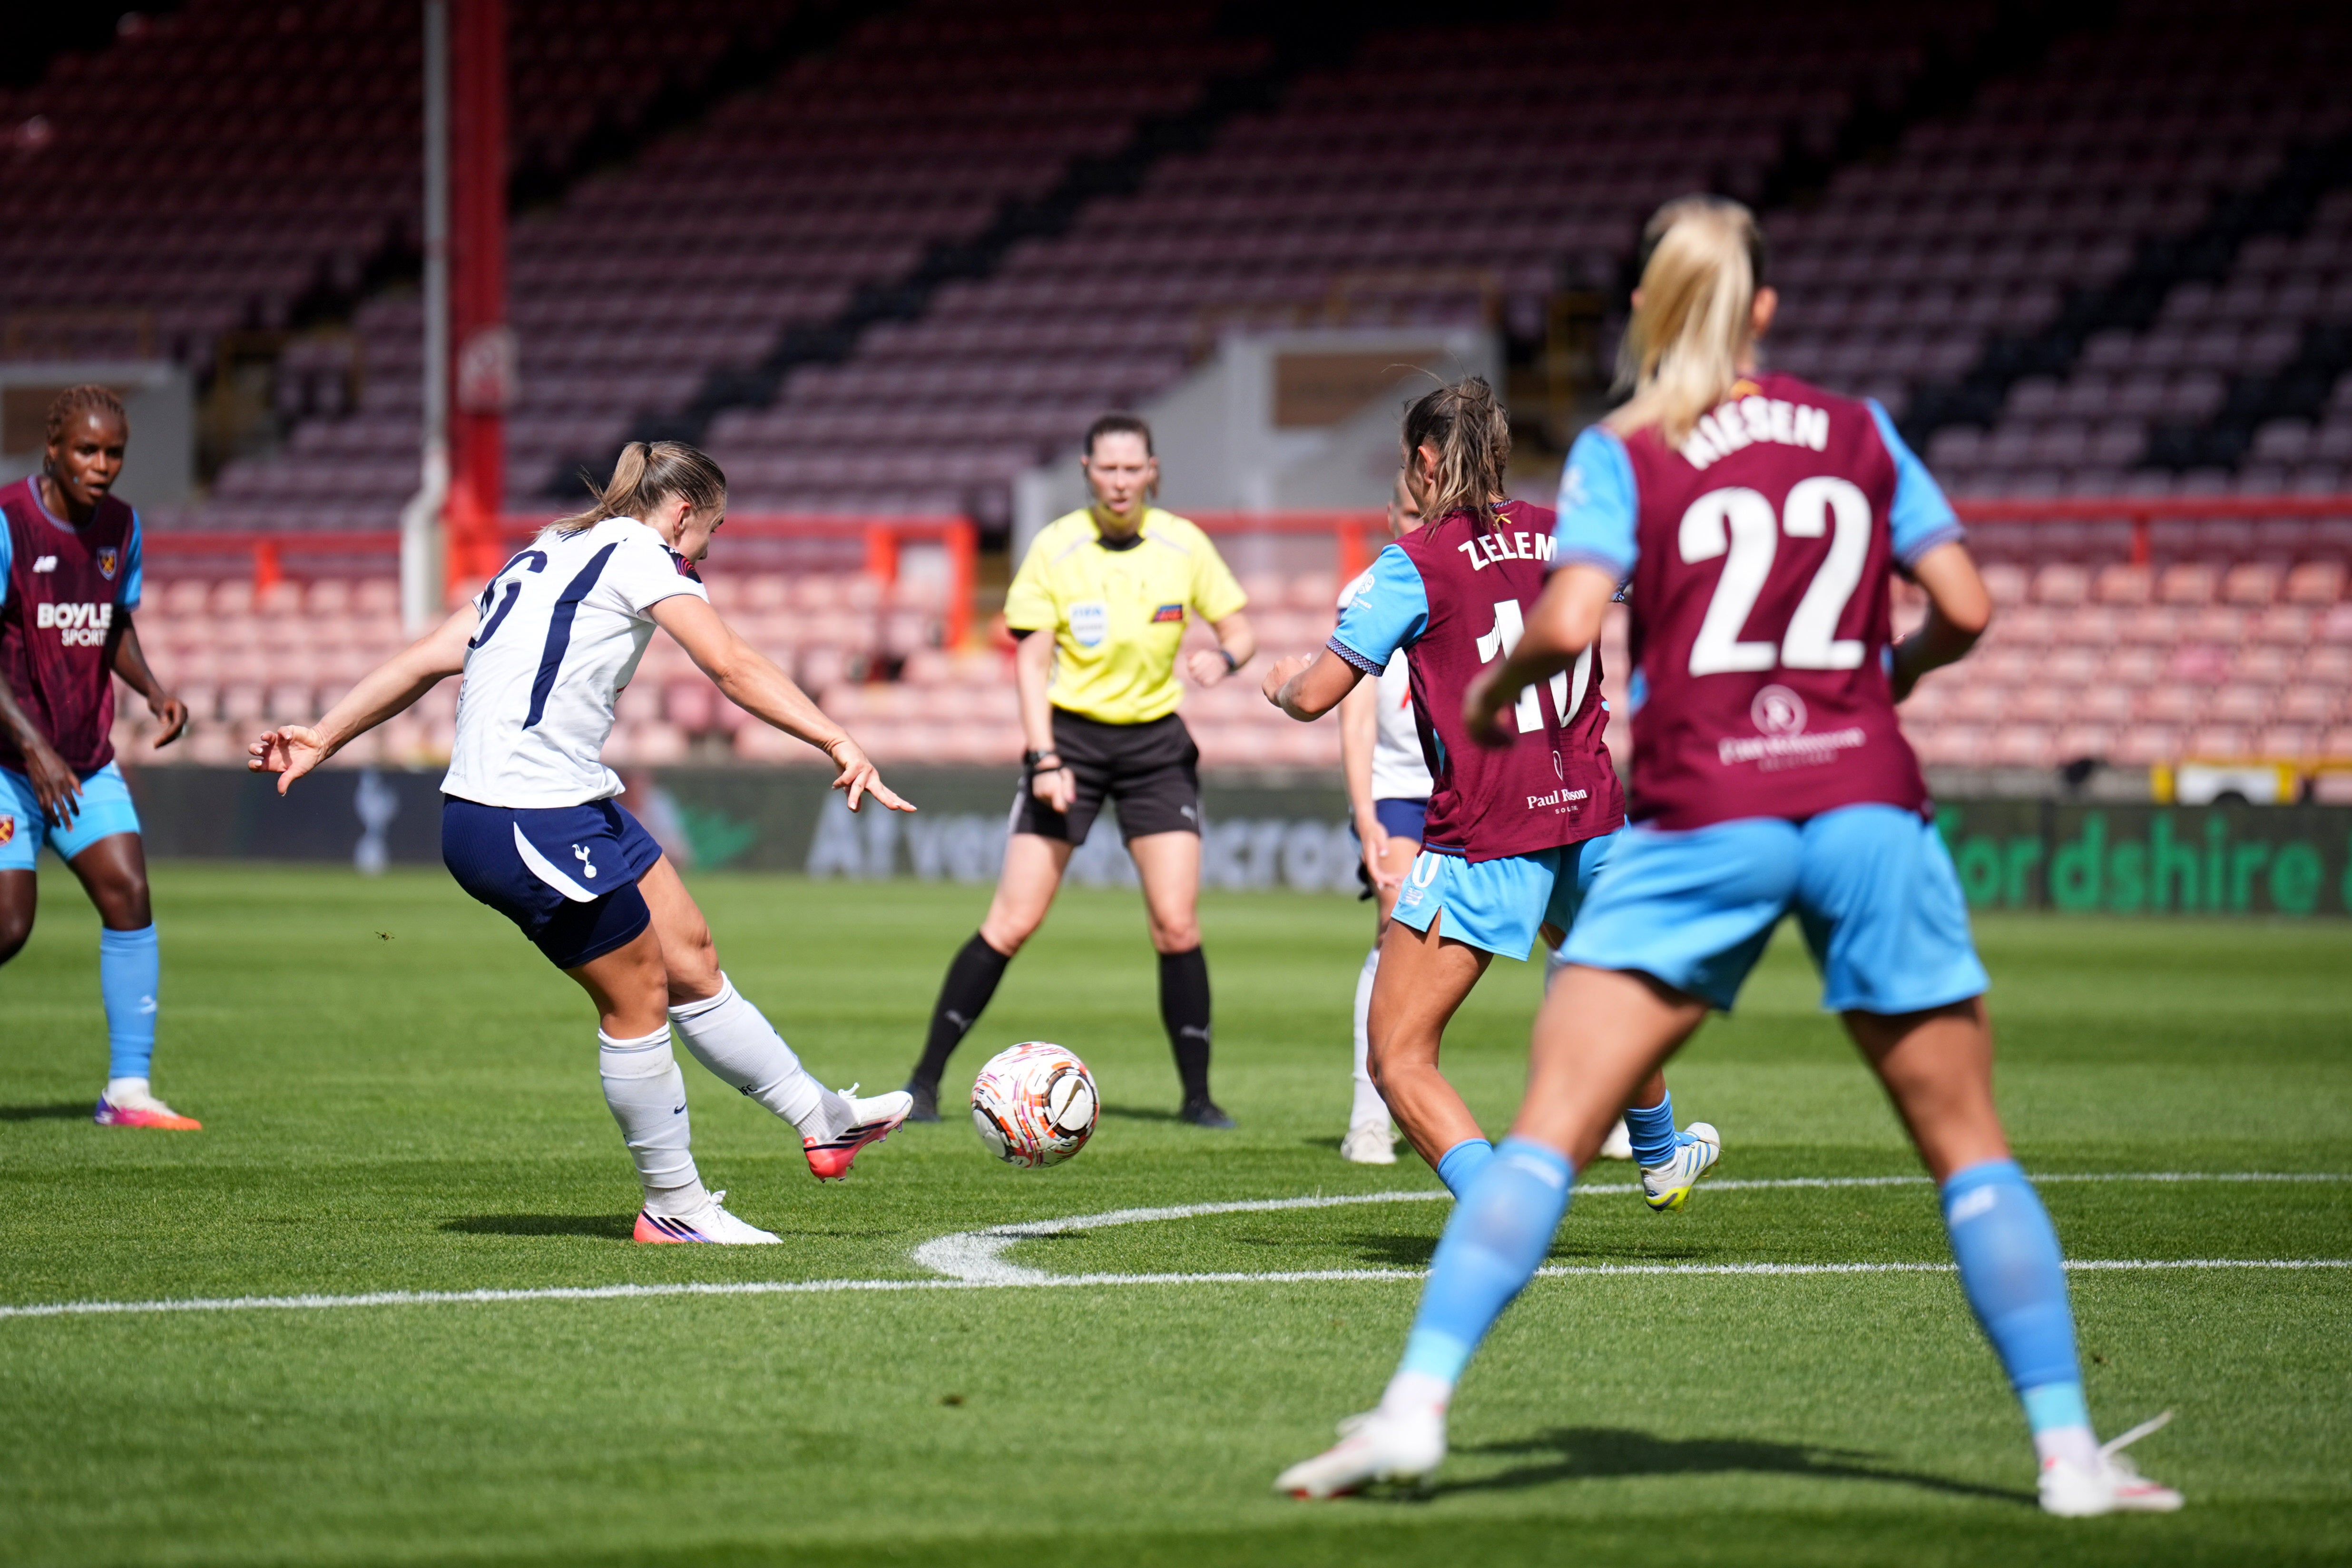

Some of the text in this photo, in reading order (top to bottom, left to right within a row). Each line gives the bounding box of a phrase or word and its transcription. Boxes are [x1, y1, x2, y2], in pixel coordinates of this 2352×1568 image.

[1458, 532, 1558, 571] ZELEM
[1678, 475, 1873, 678] 22
[37, 603, 113, 629] BOYLE
[1526, 790, 1560, 809] Paul
